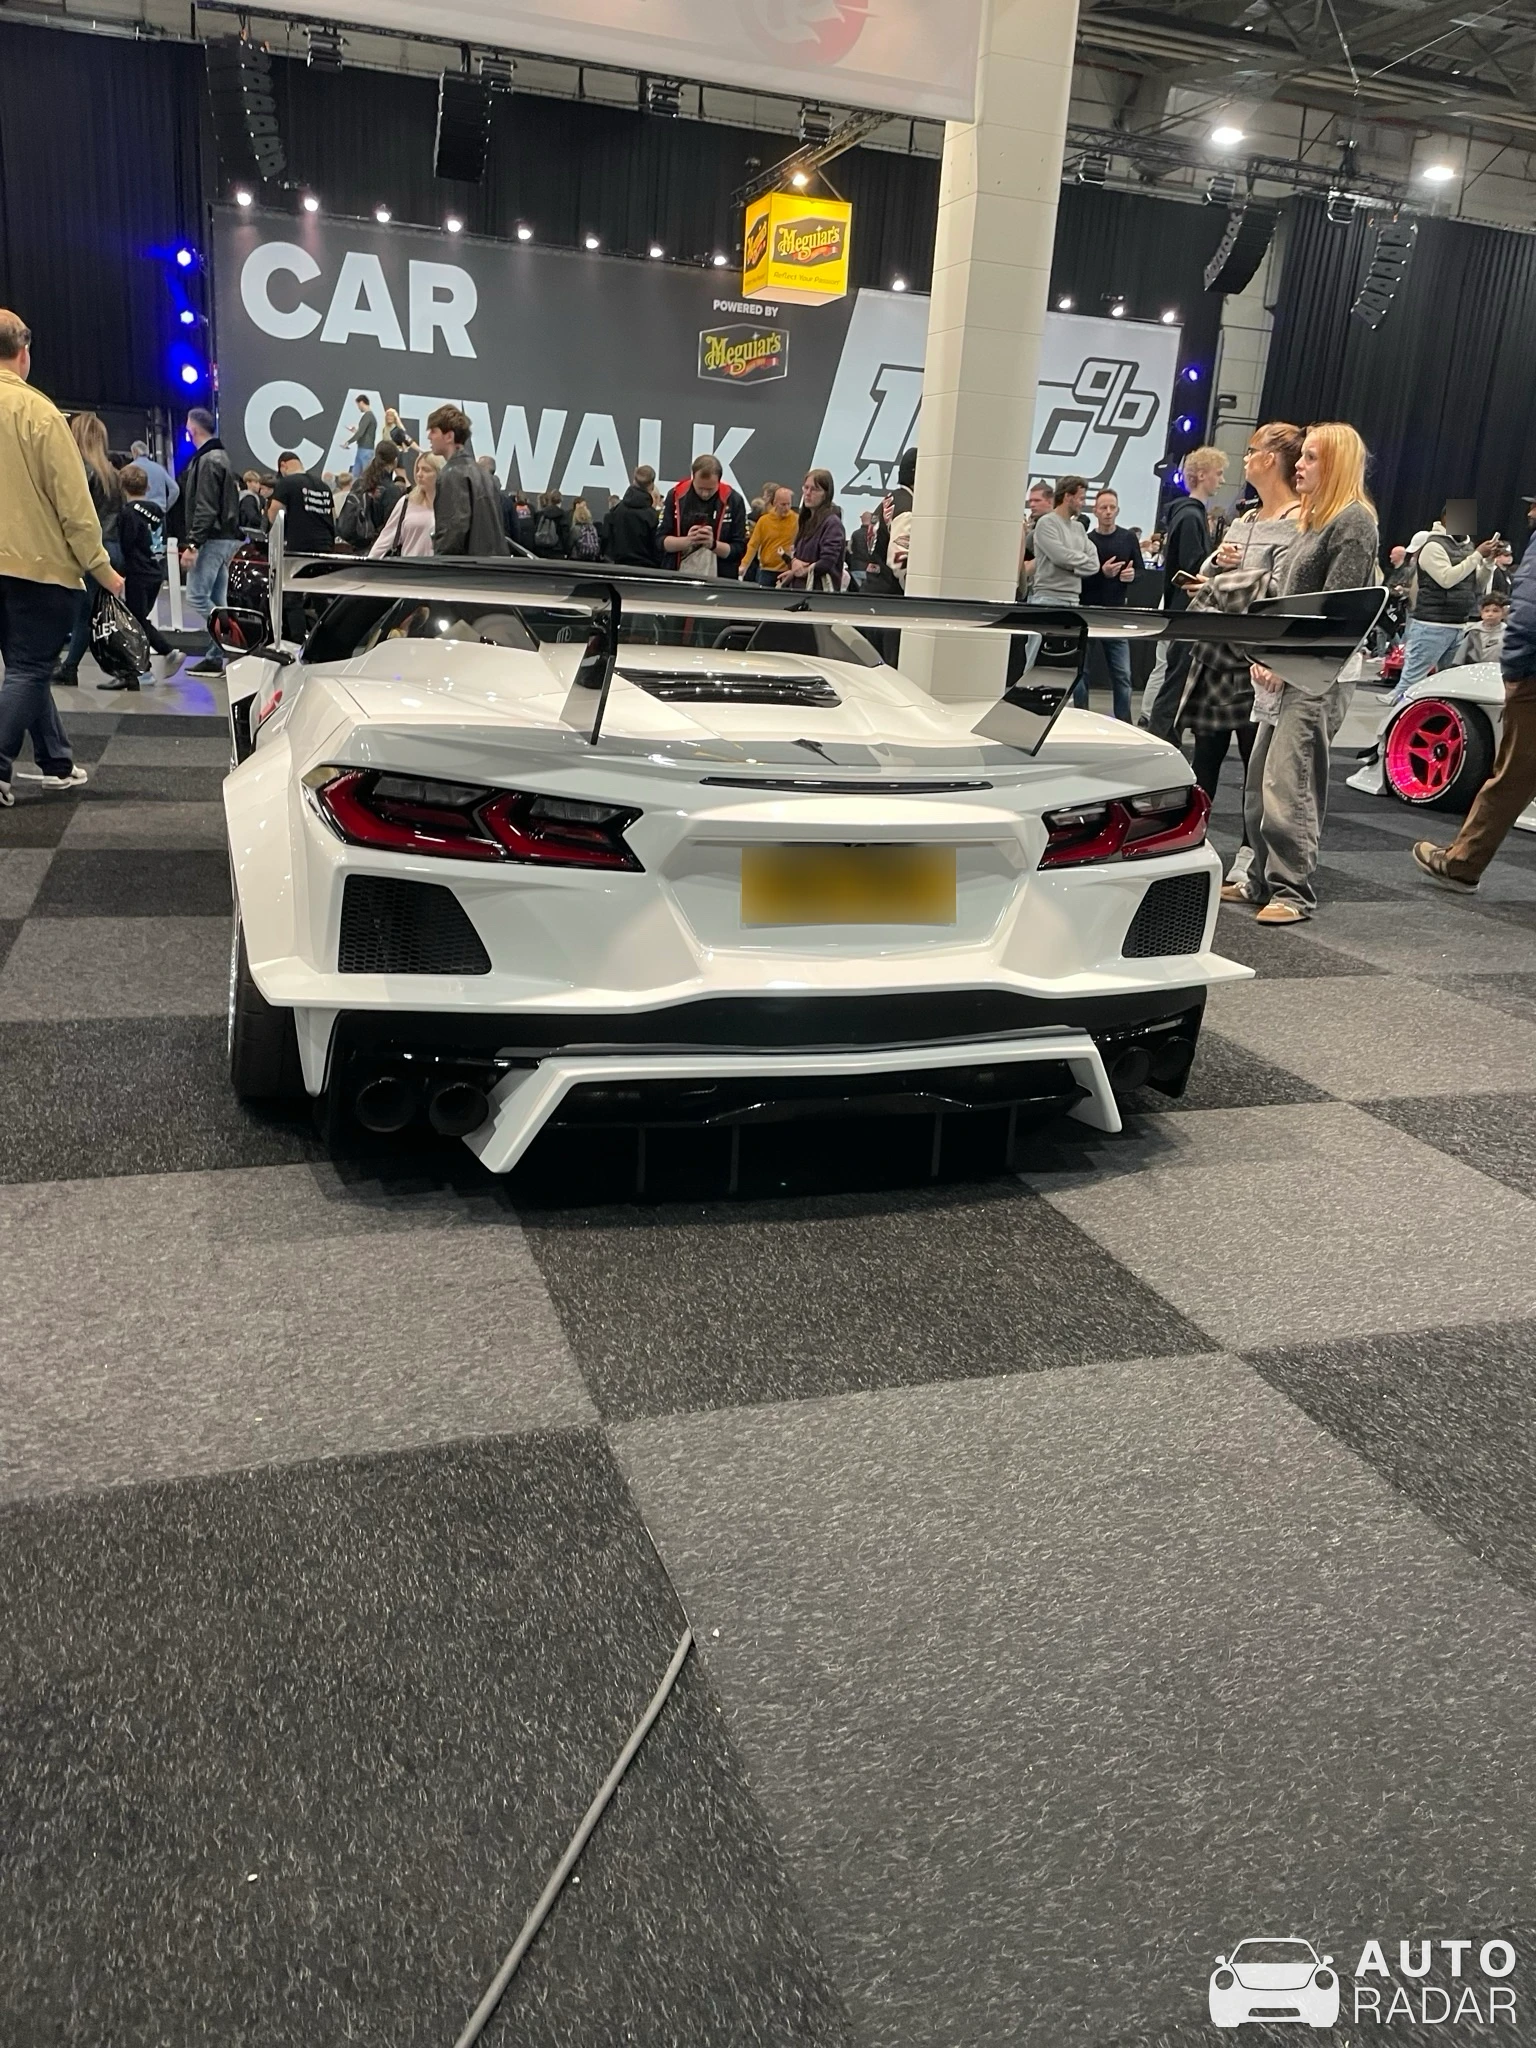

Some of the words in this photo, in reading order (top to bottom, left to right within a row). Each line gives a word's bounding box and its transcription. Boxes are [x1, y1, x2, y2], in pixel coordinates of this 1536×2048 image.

[777, 225, 840, 261] Meguiar's
[773, 271, 797, 281] Reflect
[799, 273, 813, 283] Your
[240, 241, 478, 359] CAR
[713, 299, 763, 316] POWERED
[764, 305, 779, 318] BY
[704, 332, 783, 376] Meguiar's
